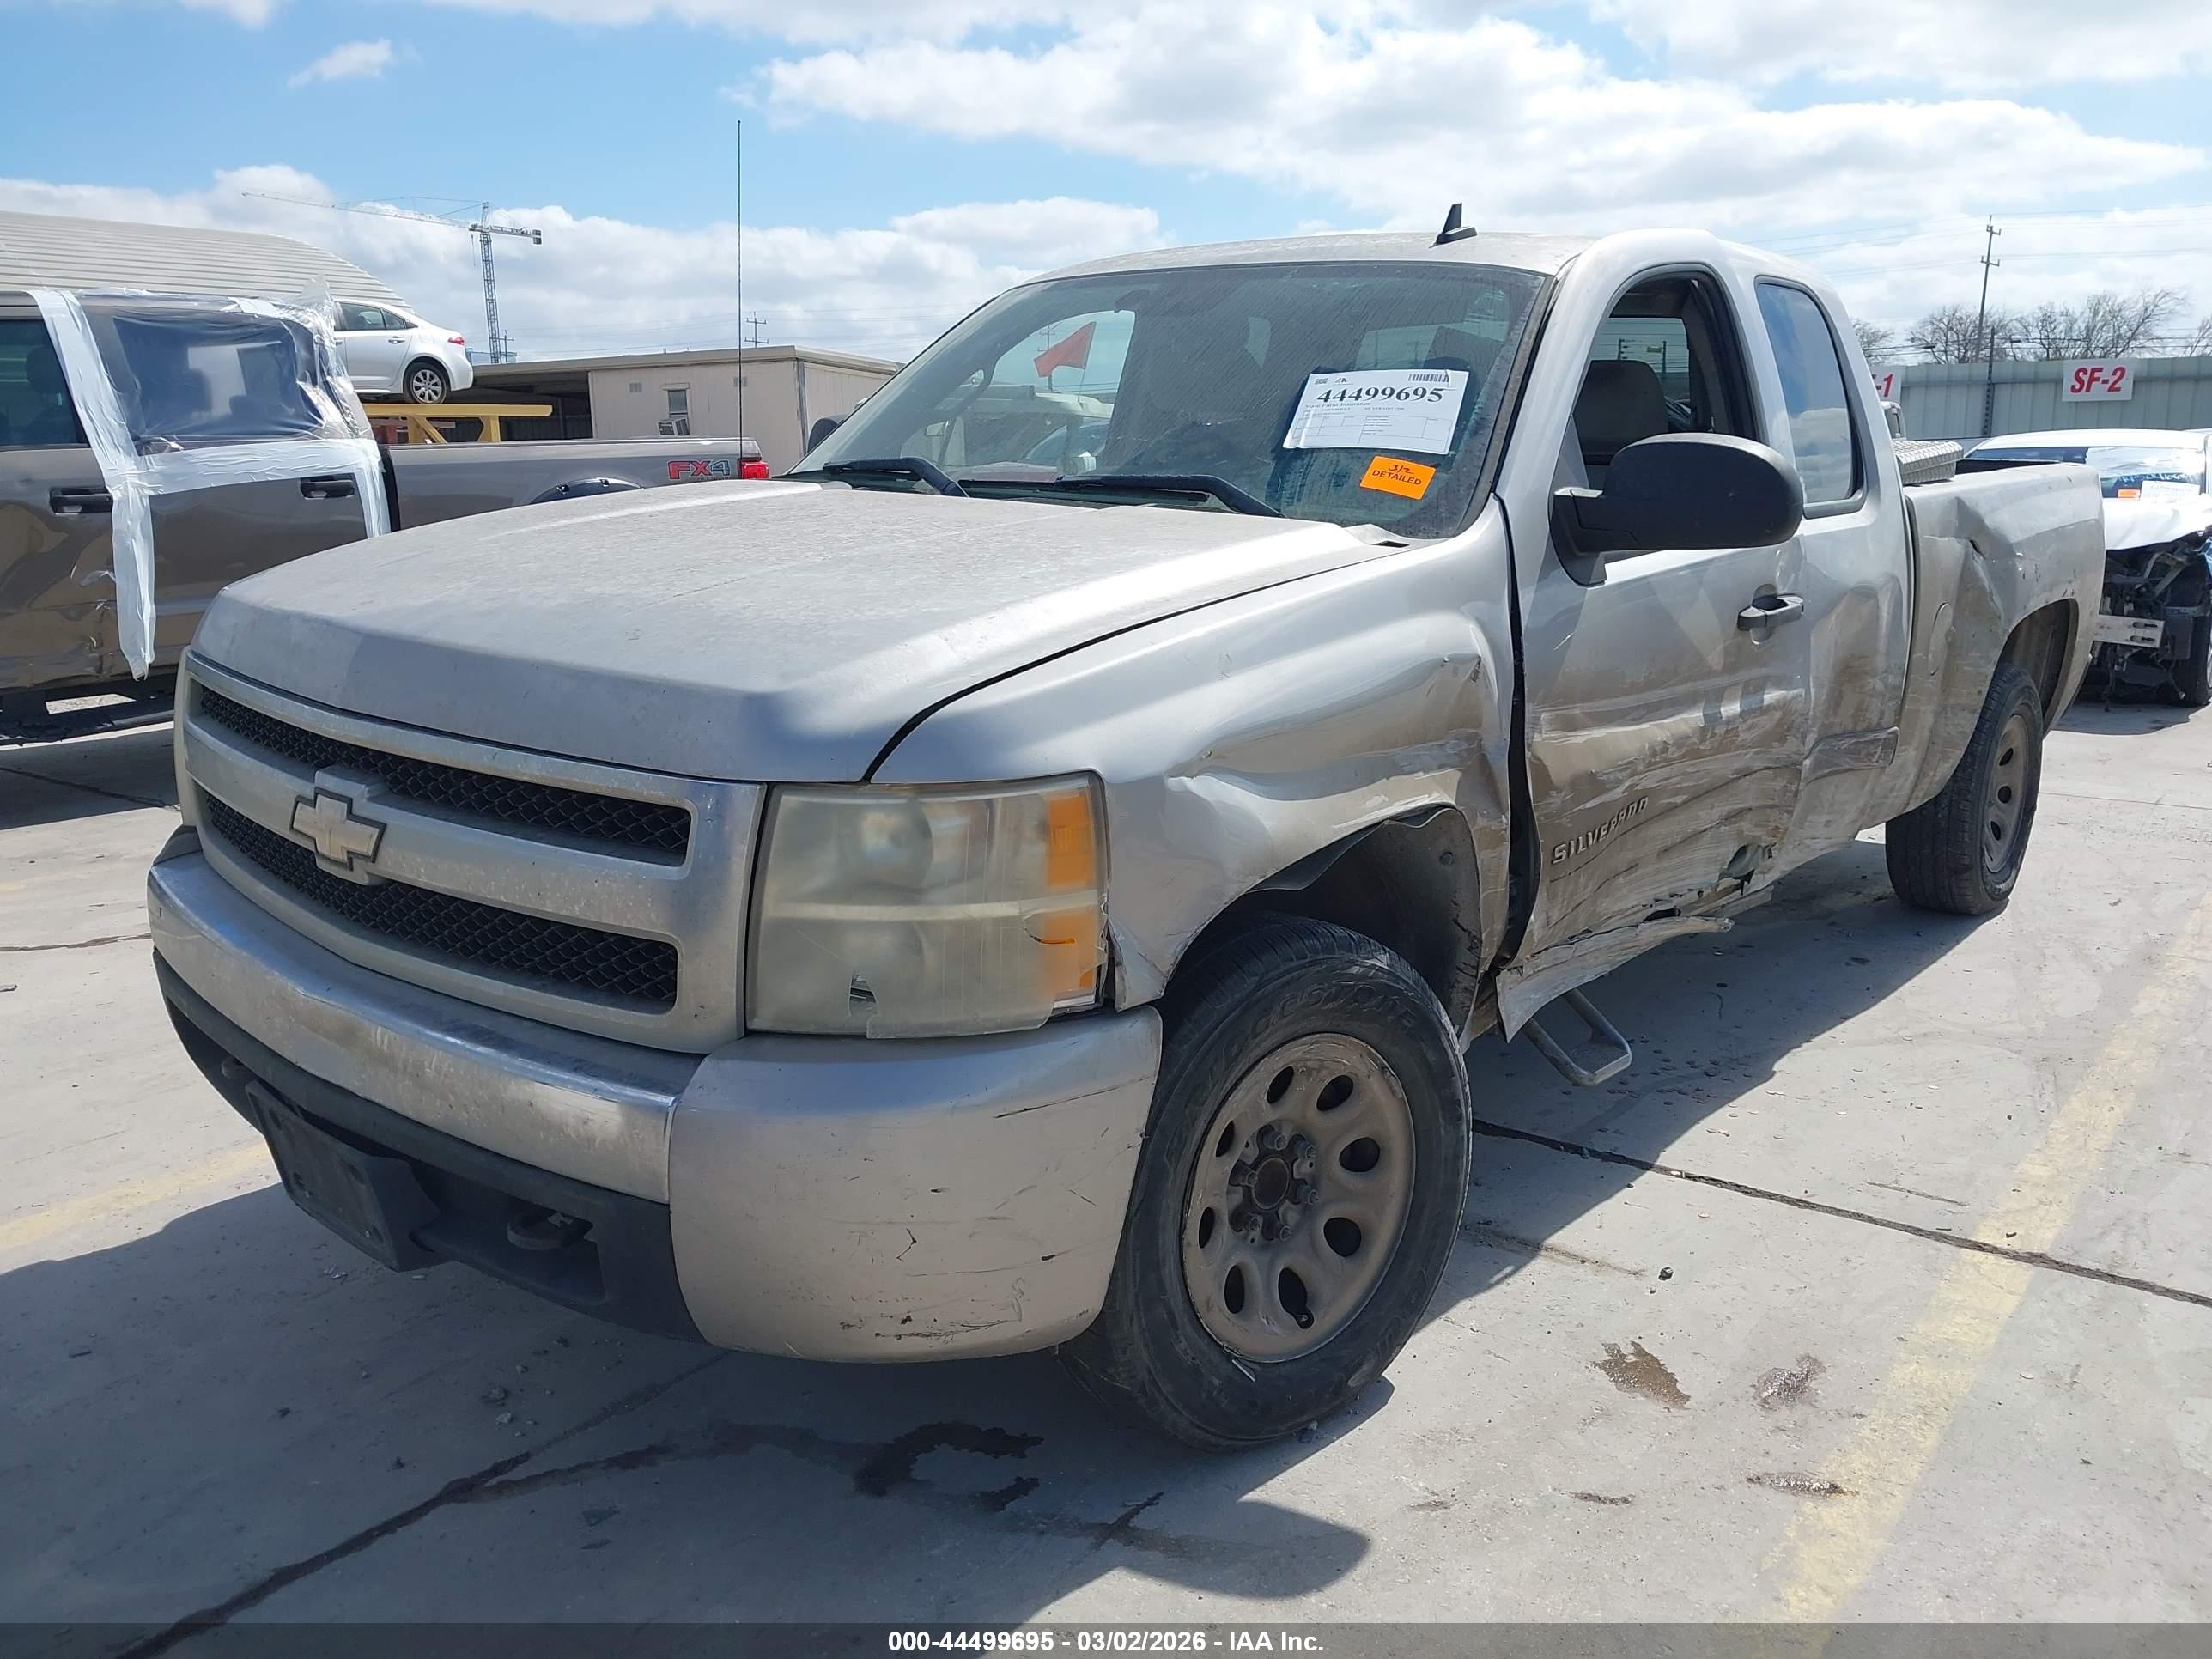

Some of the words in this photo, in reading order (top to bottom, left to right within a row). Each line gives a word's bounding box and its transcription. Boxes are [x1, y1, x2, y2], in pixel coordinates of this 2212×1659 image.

[2070, 366, 2126, 393] SF-2
[1316, 386, 1446, 403] 44499695
[668, 460, 730, 479] FX4
[1372, 470, 1422, 485] DETAILED
[1388, 464, 1414, 474] 3/2
[1551, 796, 1649, 865] SILVERADO
